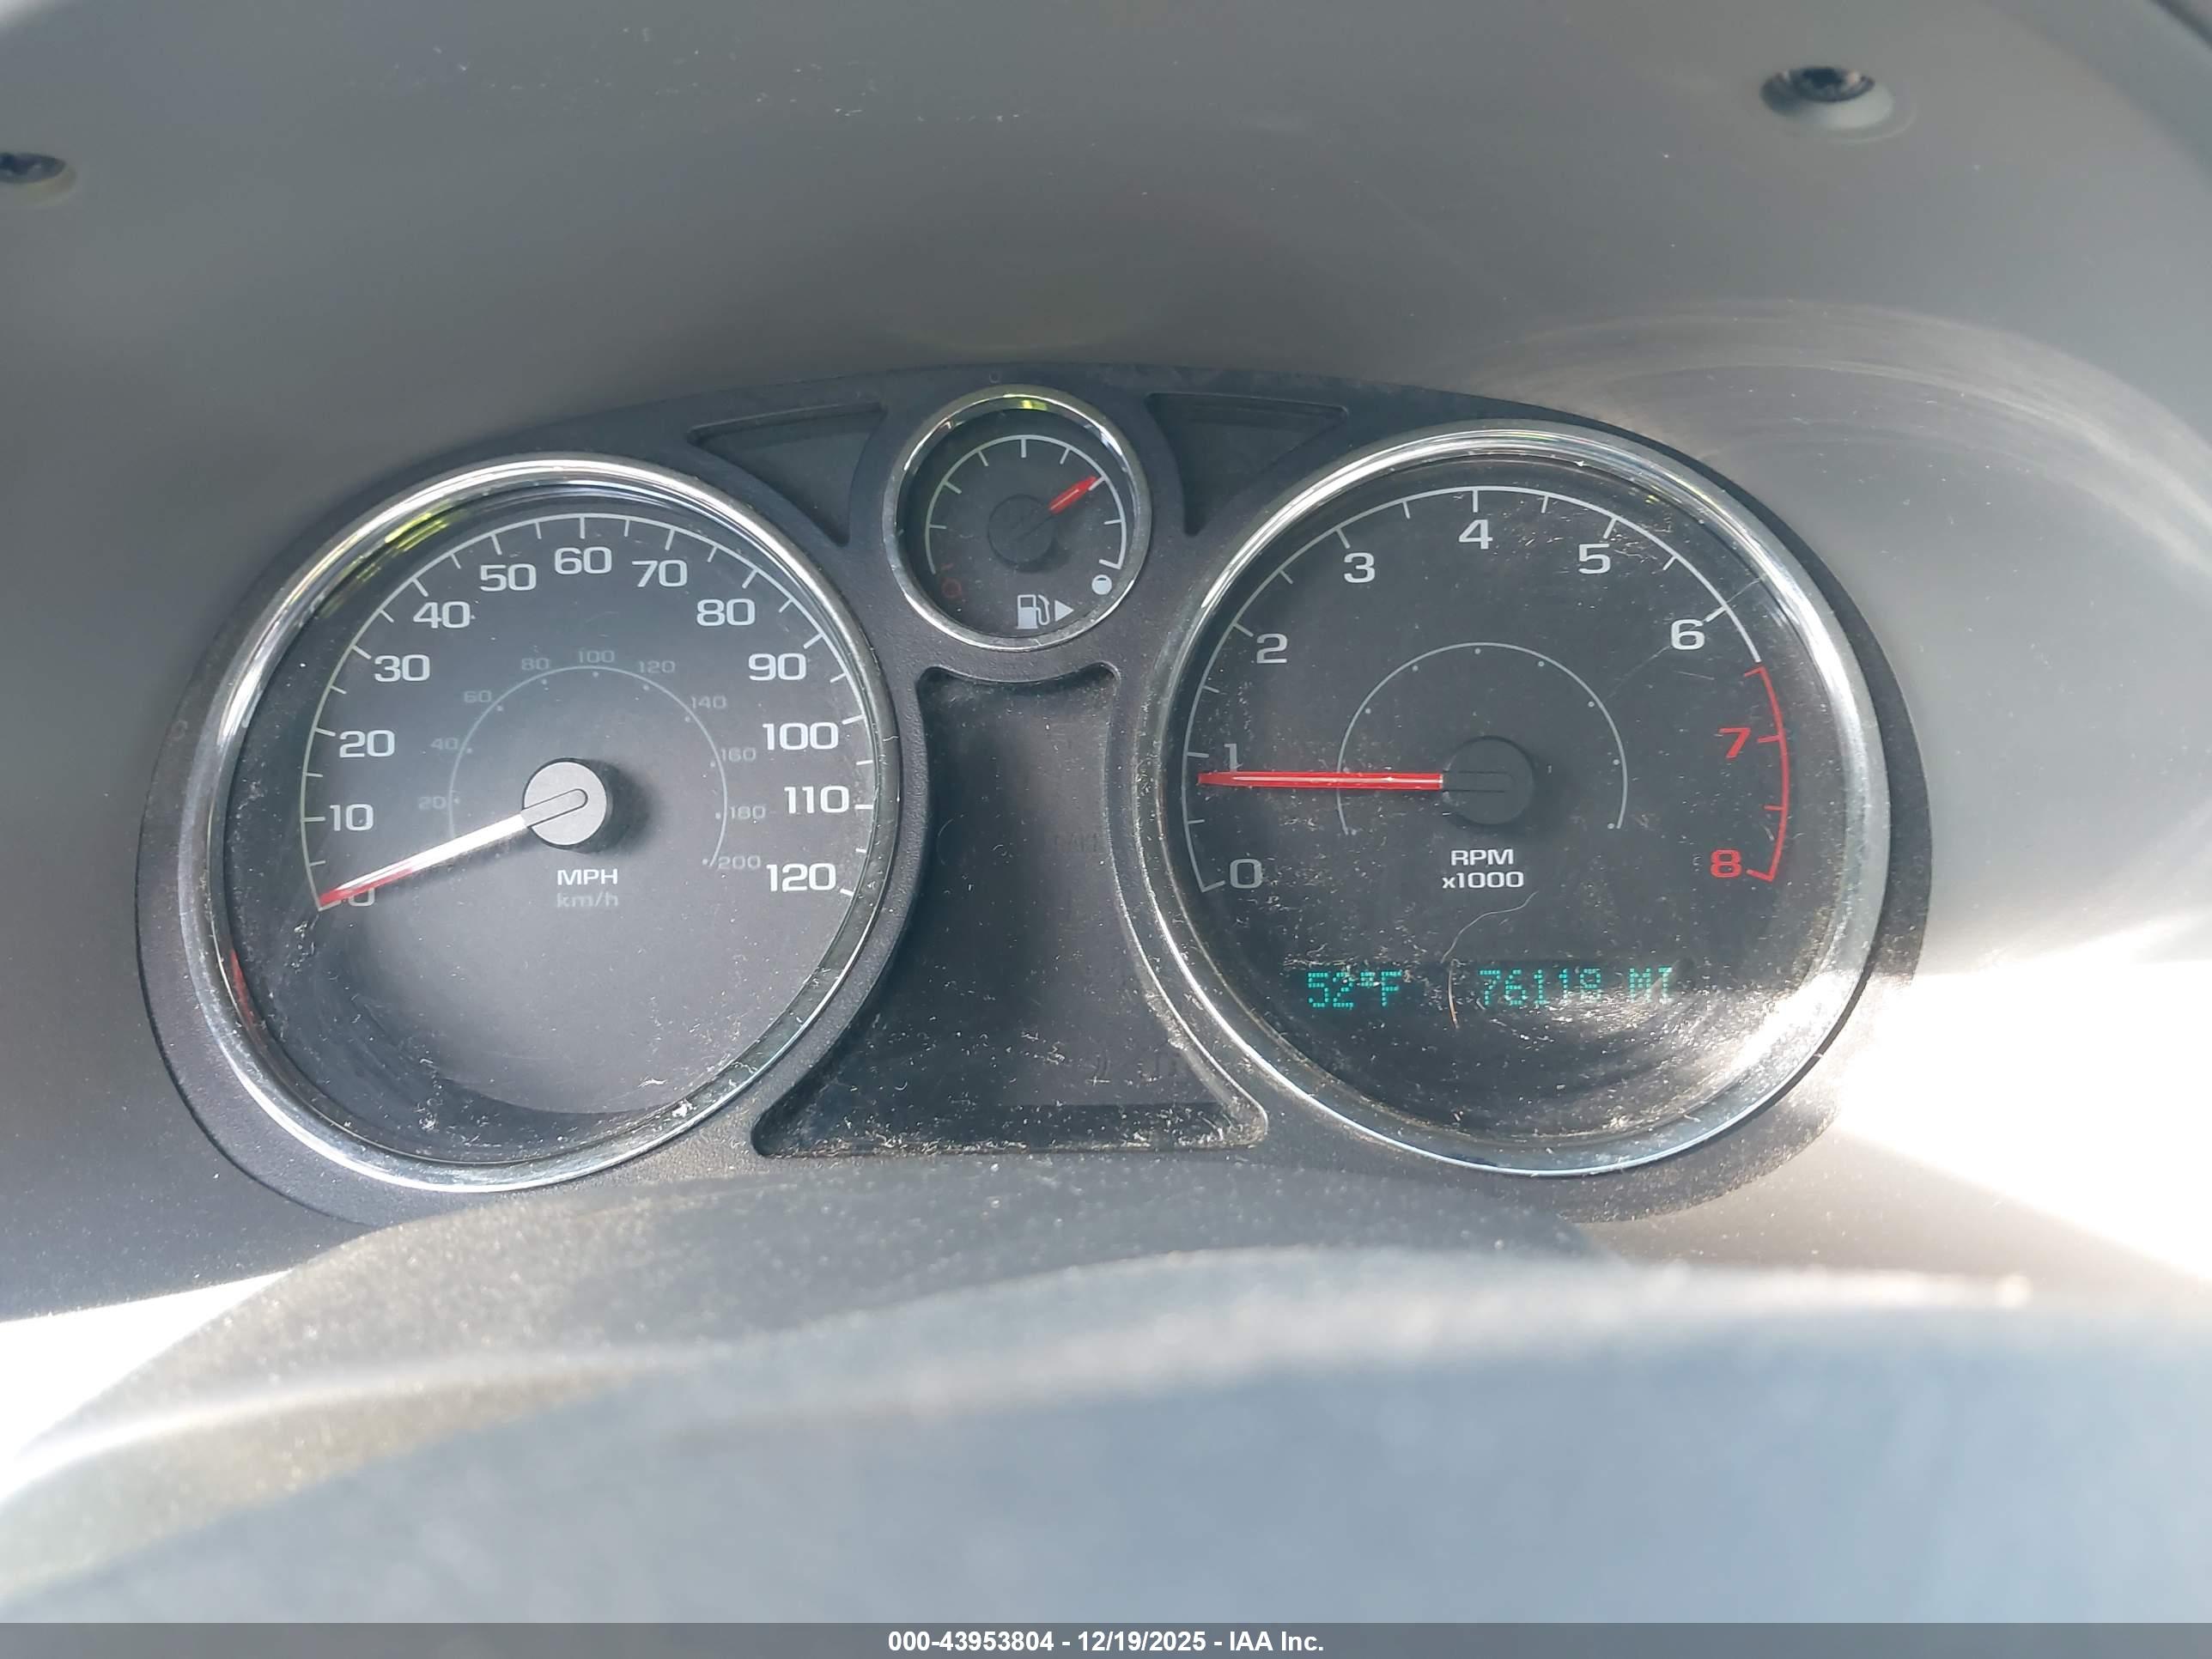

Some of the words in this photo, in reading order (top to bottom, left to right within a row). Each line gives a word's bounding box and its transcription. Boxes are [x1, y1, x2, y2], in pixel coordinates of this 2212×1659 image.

[1459, 520, 1492, 549] 4
[555, 547, 611, 574] 60
[1345, 553, 1375, 582] 3
[1579, 544, 1610, 574] 5
[481, 564, 536, 591] 50
[632, 560, 687, 586] 70
[414, 602, 470, 628] 40
[697, 599, 755, 626] 80
[1672, 619, 1705, 650] 6
[578, 651, 615, 663] 100
[1258, 634, 1287, 663] 2
[375, 654, 429, 682] 30
[521, 658, 550, 671] 80
[638, 660, 676, 674] 120
[749, 653, 805, 680] 90
[464, 690, 492, 703] 60
[691, 696, 726, 709] 140
[340, 731, 394, 757] 20
[431, 738, 459, 751] 40
[763, 722, 838, 750] 100
[1722, 727, 1750, 757] 7
[722, 749, 756, 761] 160
[1224, 743, 1237, 774] 1
[418, 795, 447, 810] 20
[731, 806, 765, 819] 180
[785, 786, 849, 813] 110
[331, 804, 374, 830] 10
[717, 855, 761, 870] 200
[1452, 849, 1513, 865] RPM
[1711, 850, 1741, 877] 8
[558, 869, 617, 884] MPH
[767, 863, 836, 891] 120
[1231, 859, 1263, 888] 0
[1443, 872, 1523, 888] x1000
[557, 892, 618, 908] km/h
[1479, 968, 1601, 1006] 76118
